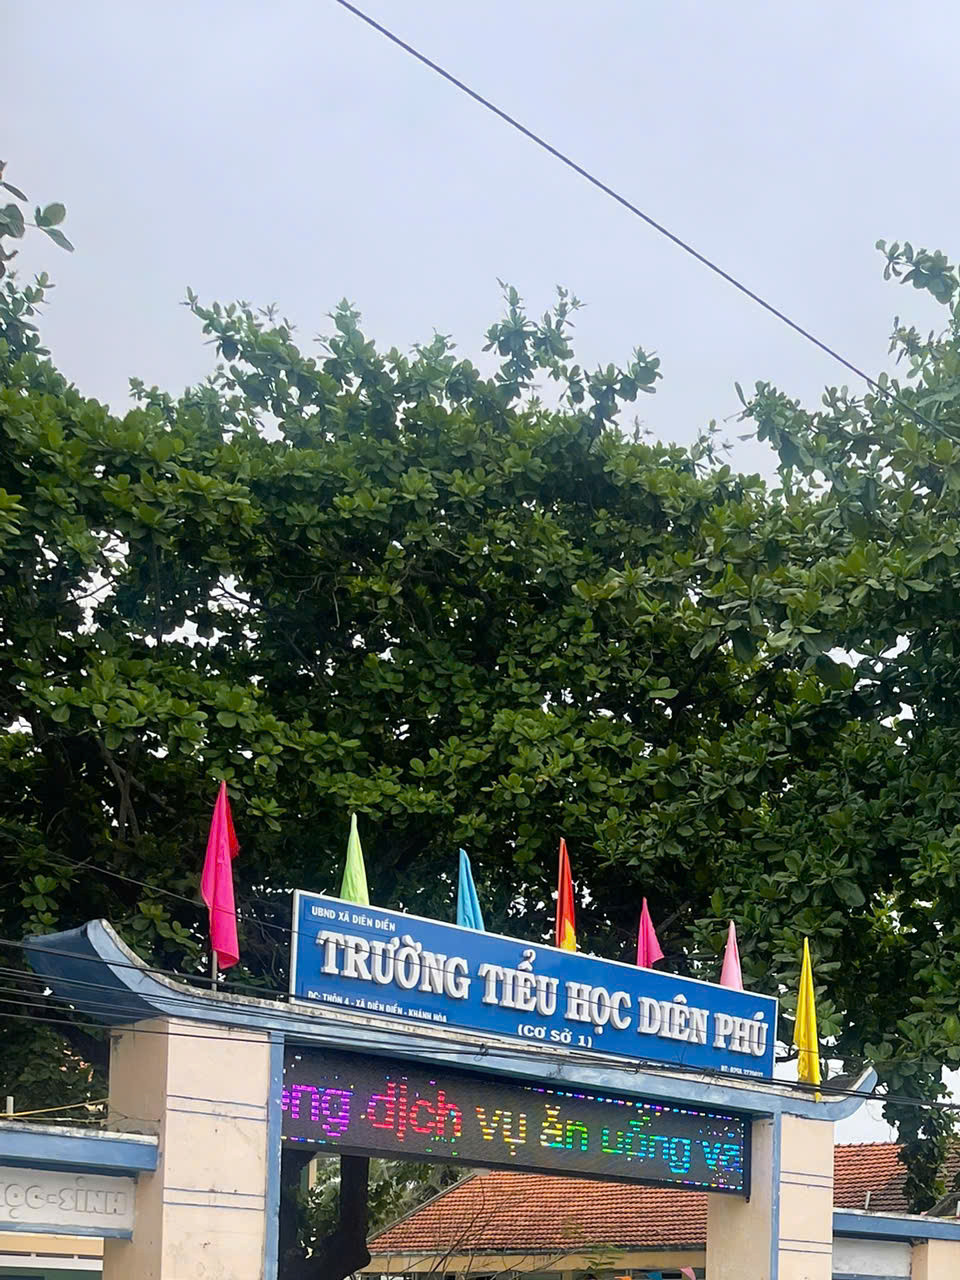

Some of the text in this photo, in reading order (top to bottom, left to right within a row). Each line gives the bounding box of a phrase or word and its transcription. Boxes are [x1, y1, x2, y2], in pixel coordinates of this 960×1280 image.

[312, 906, 336, 920] UBND
[338, 910, 350, 922] XÃ
[315, 930, 768, 1057] TRƯỜNG TIỂU HỌC DIÊN PHÚ
[322, 992, 343, 1004] THÔN
[408, 1009, 432, 1020] KHÁNH
[517, 1024, 592, 1049] (CƠ SỞ 1)
[367, 1082, 462, 1142] dịch
[476, 1107, 527, 1156] vụ
[539, 1104, 589, 1151] ăn
[602, 1109, 691, 1174] uống
